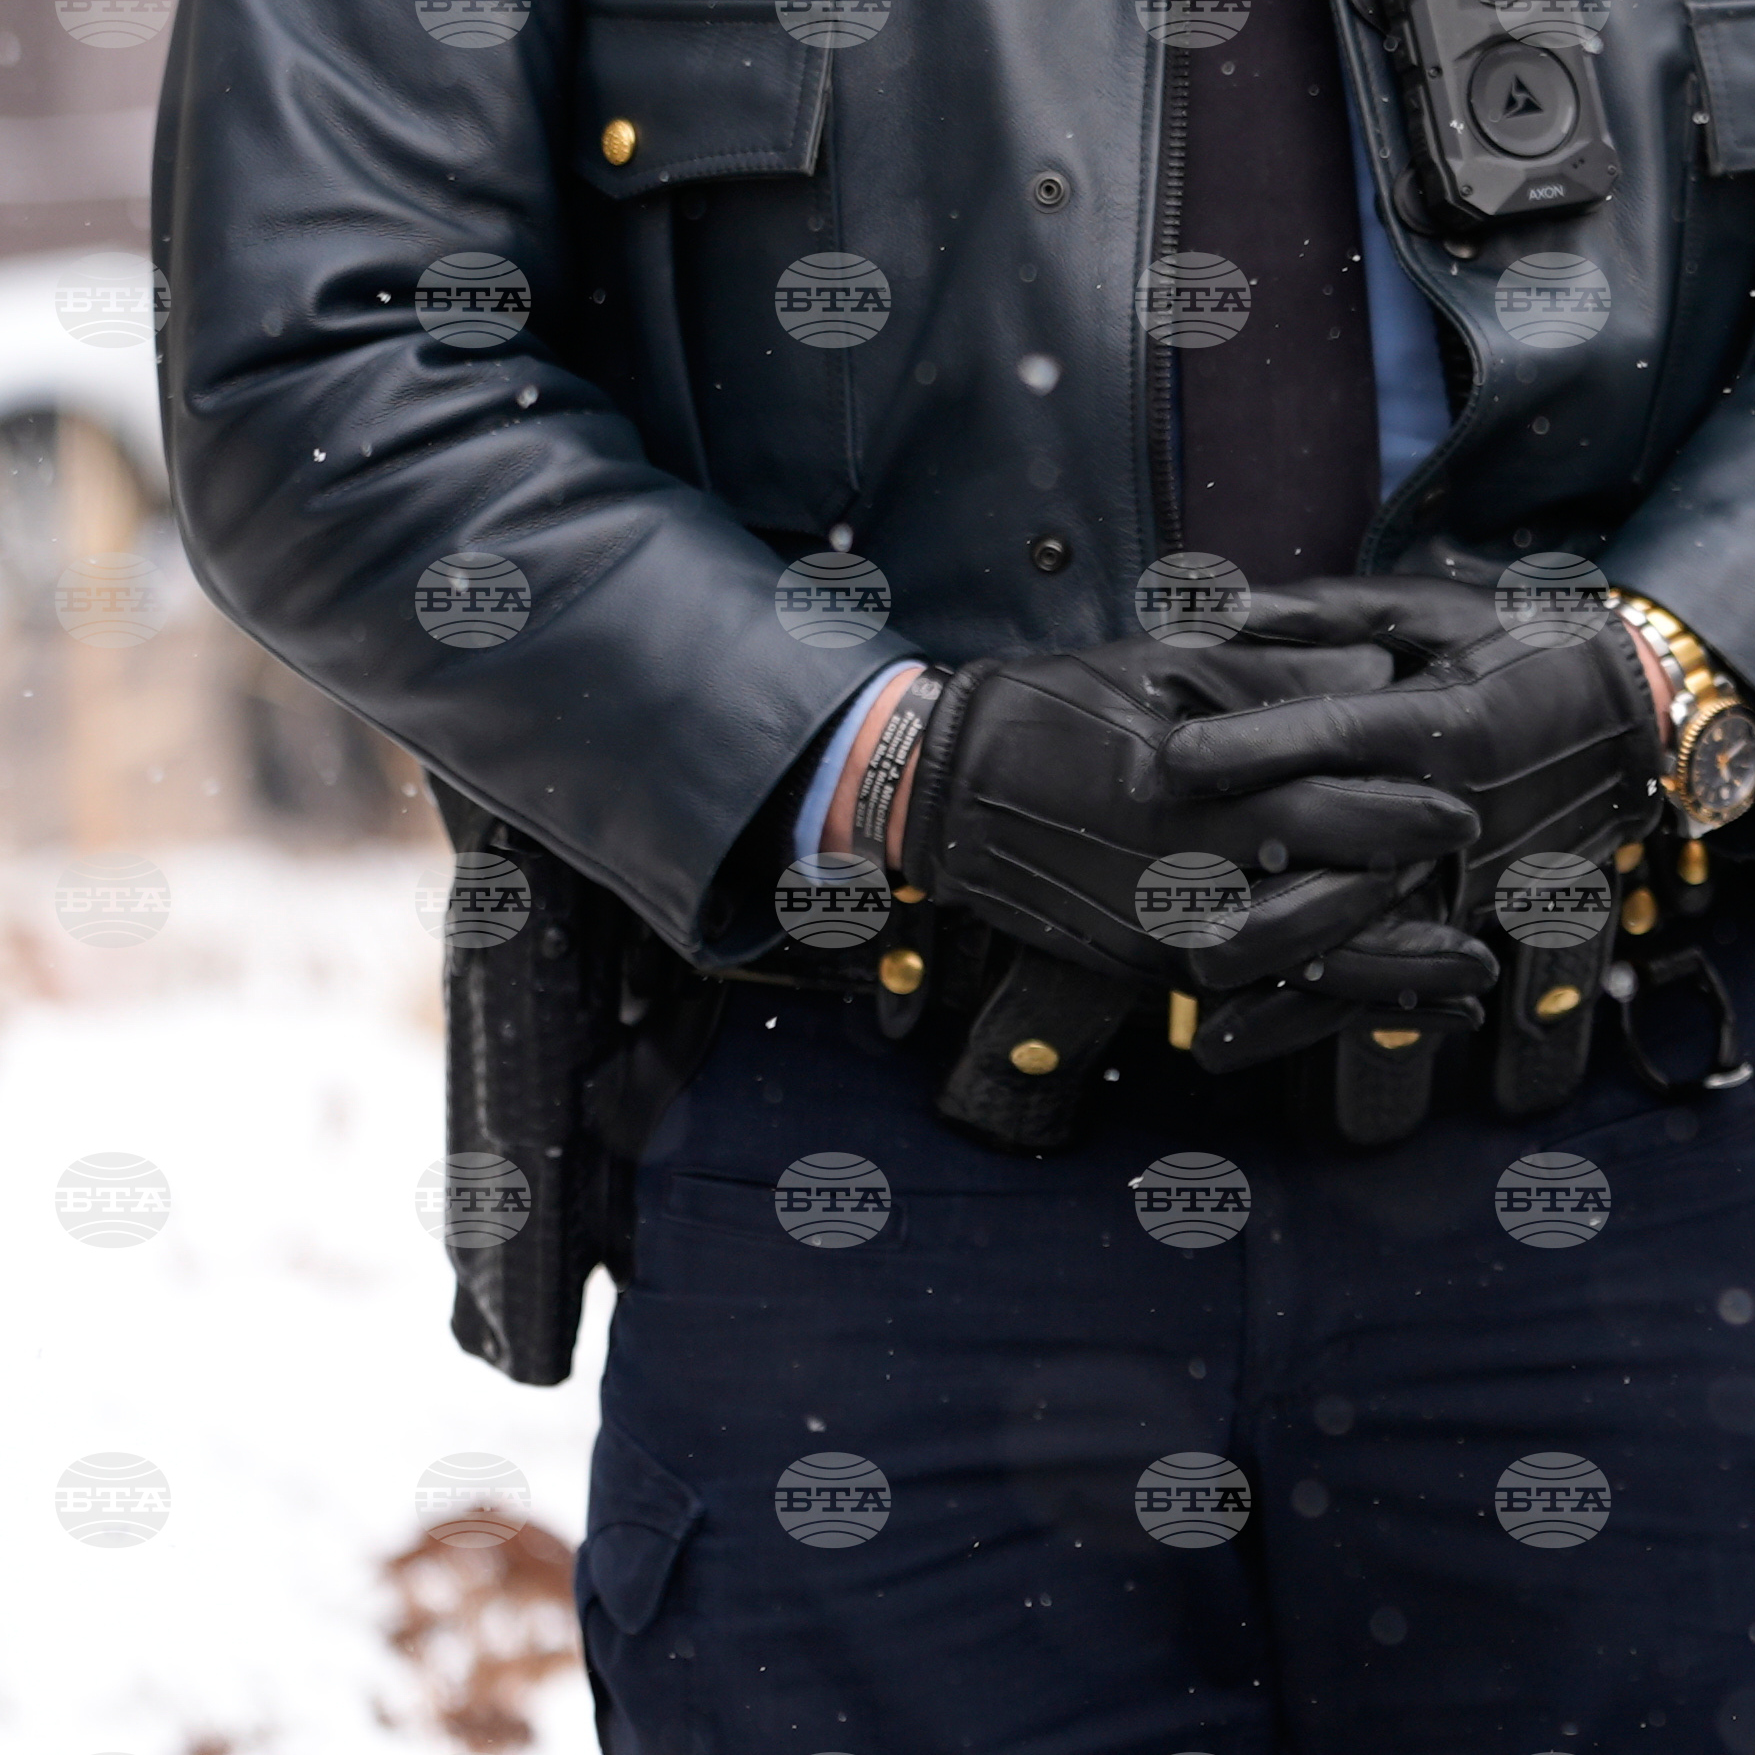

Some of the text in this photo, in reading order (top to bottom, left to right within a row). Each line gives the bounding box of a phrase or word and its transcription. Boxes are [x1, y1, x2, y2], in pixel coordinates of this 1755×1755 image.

[1527, 182, 1566, 202] AXON
[882, 714, 901, 745] EOW
[869, 743, 887, 769] May
